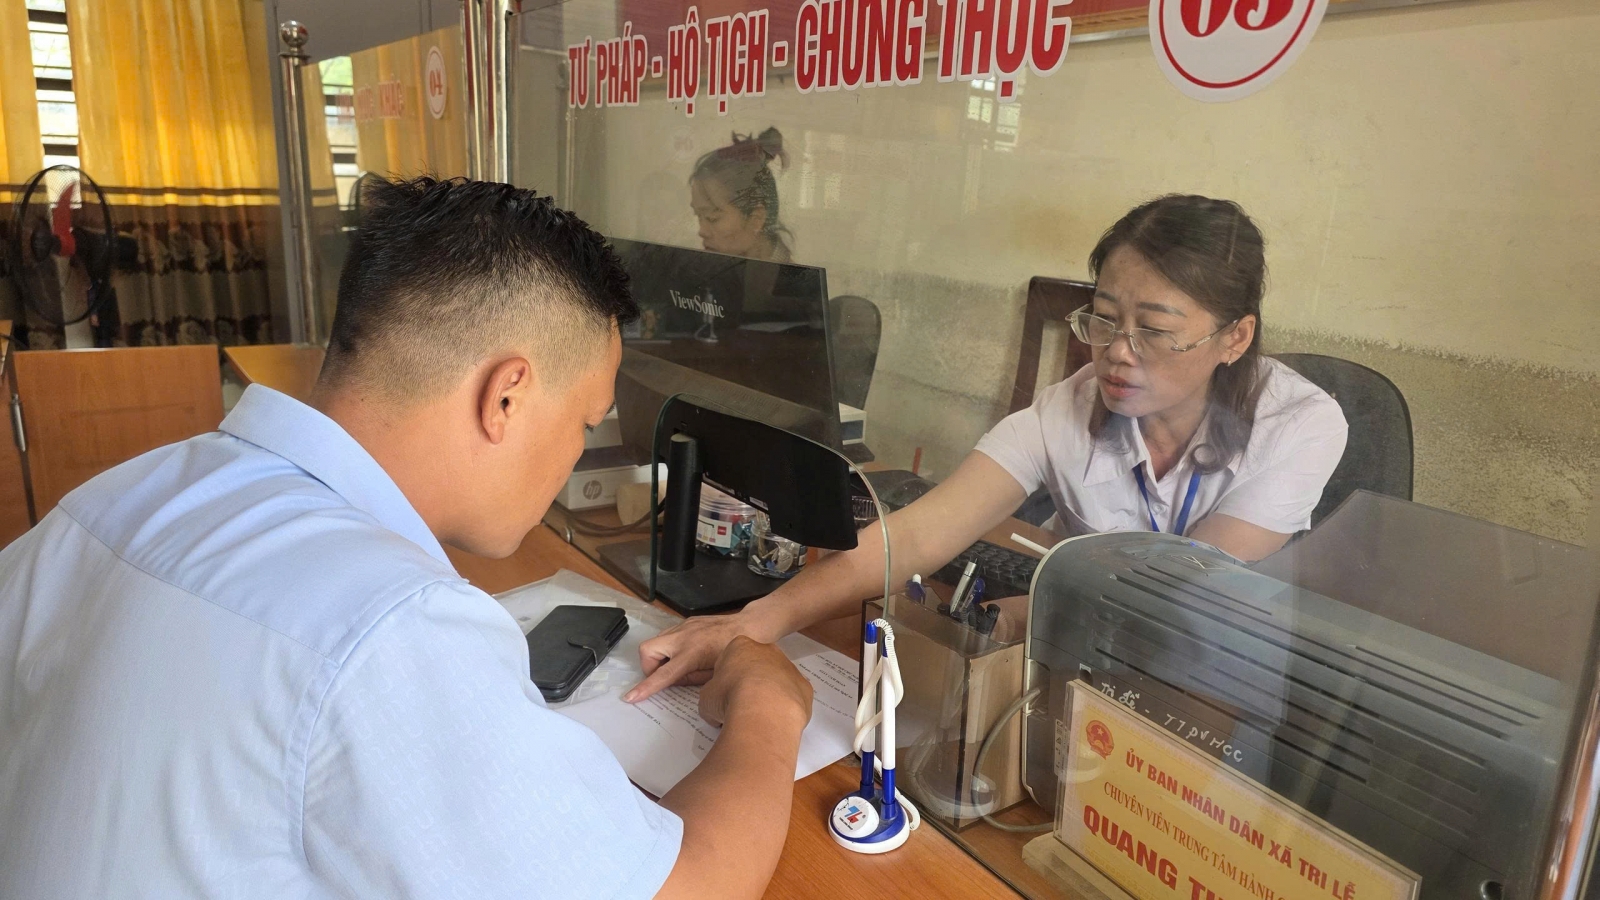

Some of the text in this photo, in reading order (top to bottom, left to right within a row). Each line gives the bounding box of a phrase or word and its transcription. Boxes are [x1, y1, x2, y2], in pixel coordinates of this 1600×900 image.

[568, 37, 591, 106] TƯ
[596, 23, 646, 105] PHÁP
[667, 9, 699, 114] HỘ
[707, 13, 766, 113] TỊCH
[669, 289, 725, 318] ViewSonic
[583, 480, 602, 500] hp
[1083, 804, 1179, 891] QUANG
[1104, 781, 1275, 900] CHUYÊN VIÊN TRUNG TÂM HÀNH
[1126, 748, 1144, 773] ỦY
[1147, 764, 1178, 795] BAN
[1181, 785, 1225, 825] NHÂN
[1229, 815, 1264, 850] DÂN
[1268, 839, 1293, 869] XÃ
[1299, 857, 1328, 890] TRI
